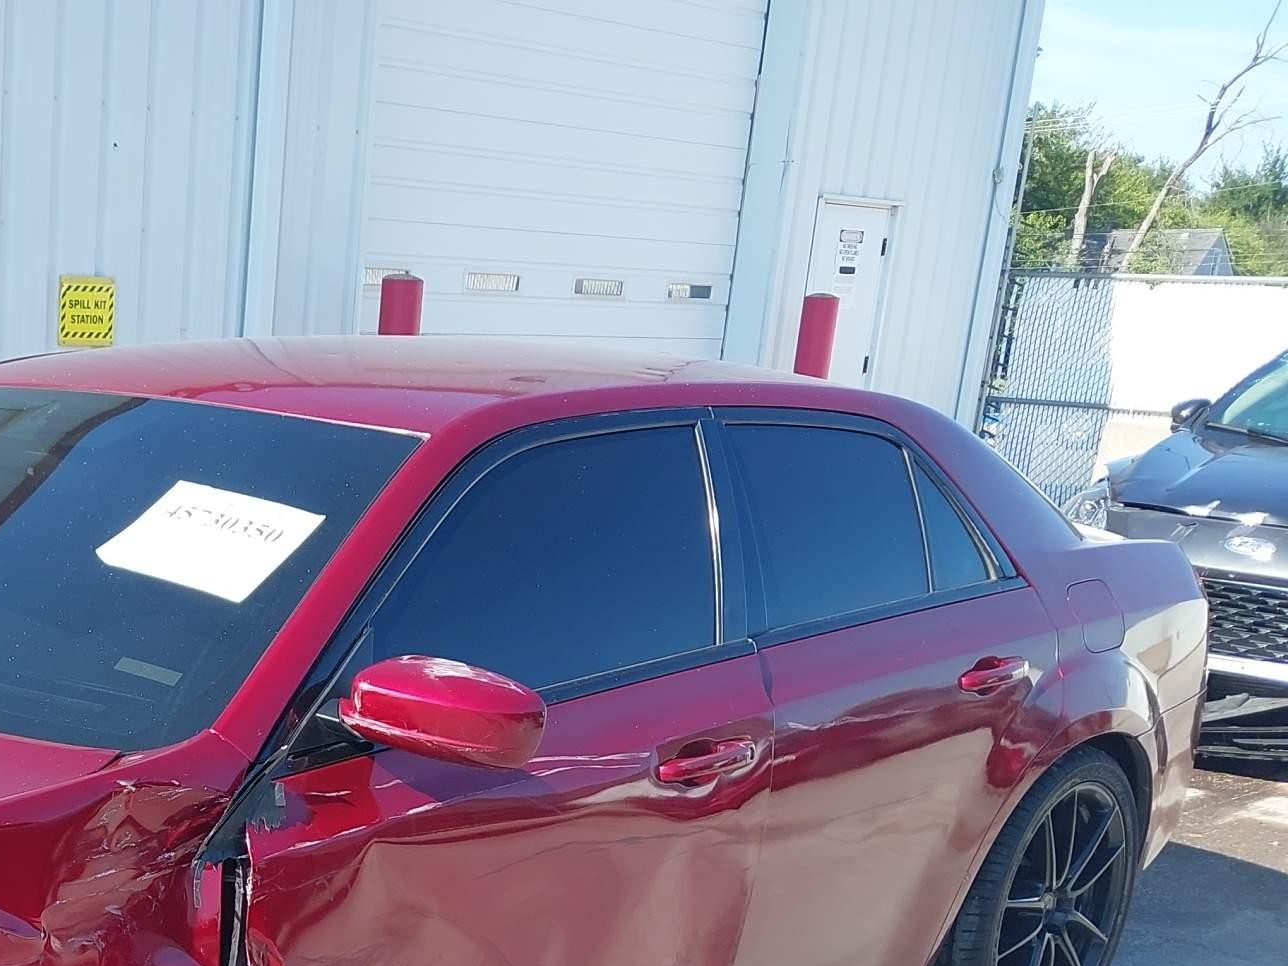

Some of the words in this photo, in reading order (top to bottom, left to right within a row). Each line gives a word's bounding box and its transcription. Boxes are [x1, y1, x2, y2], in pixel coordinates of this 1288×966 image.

[68, 299, 91, 310] SPILL
[94, 299, 107, 310] KIT
[70, 314, 104, 325] STATION
